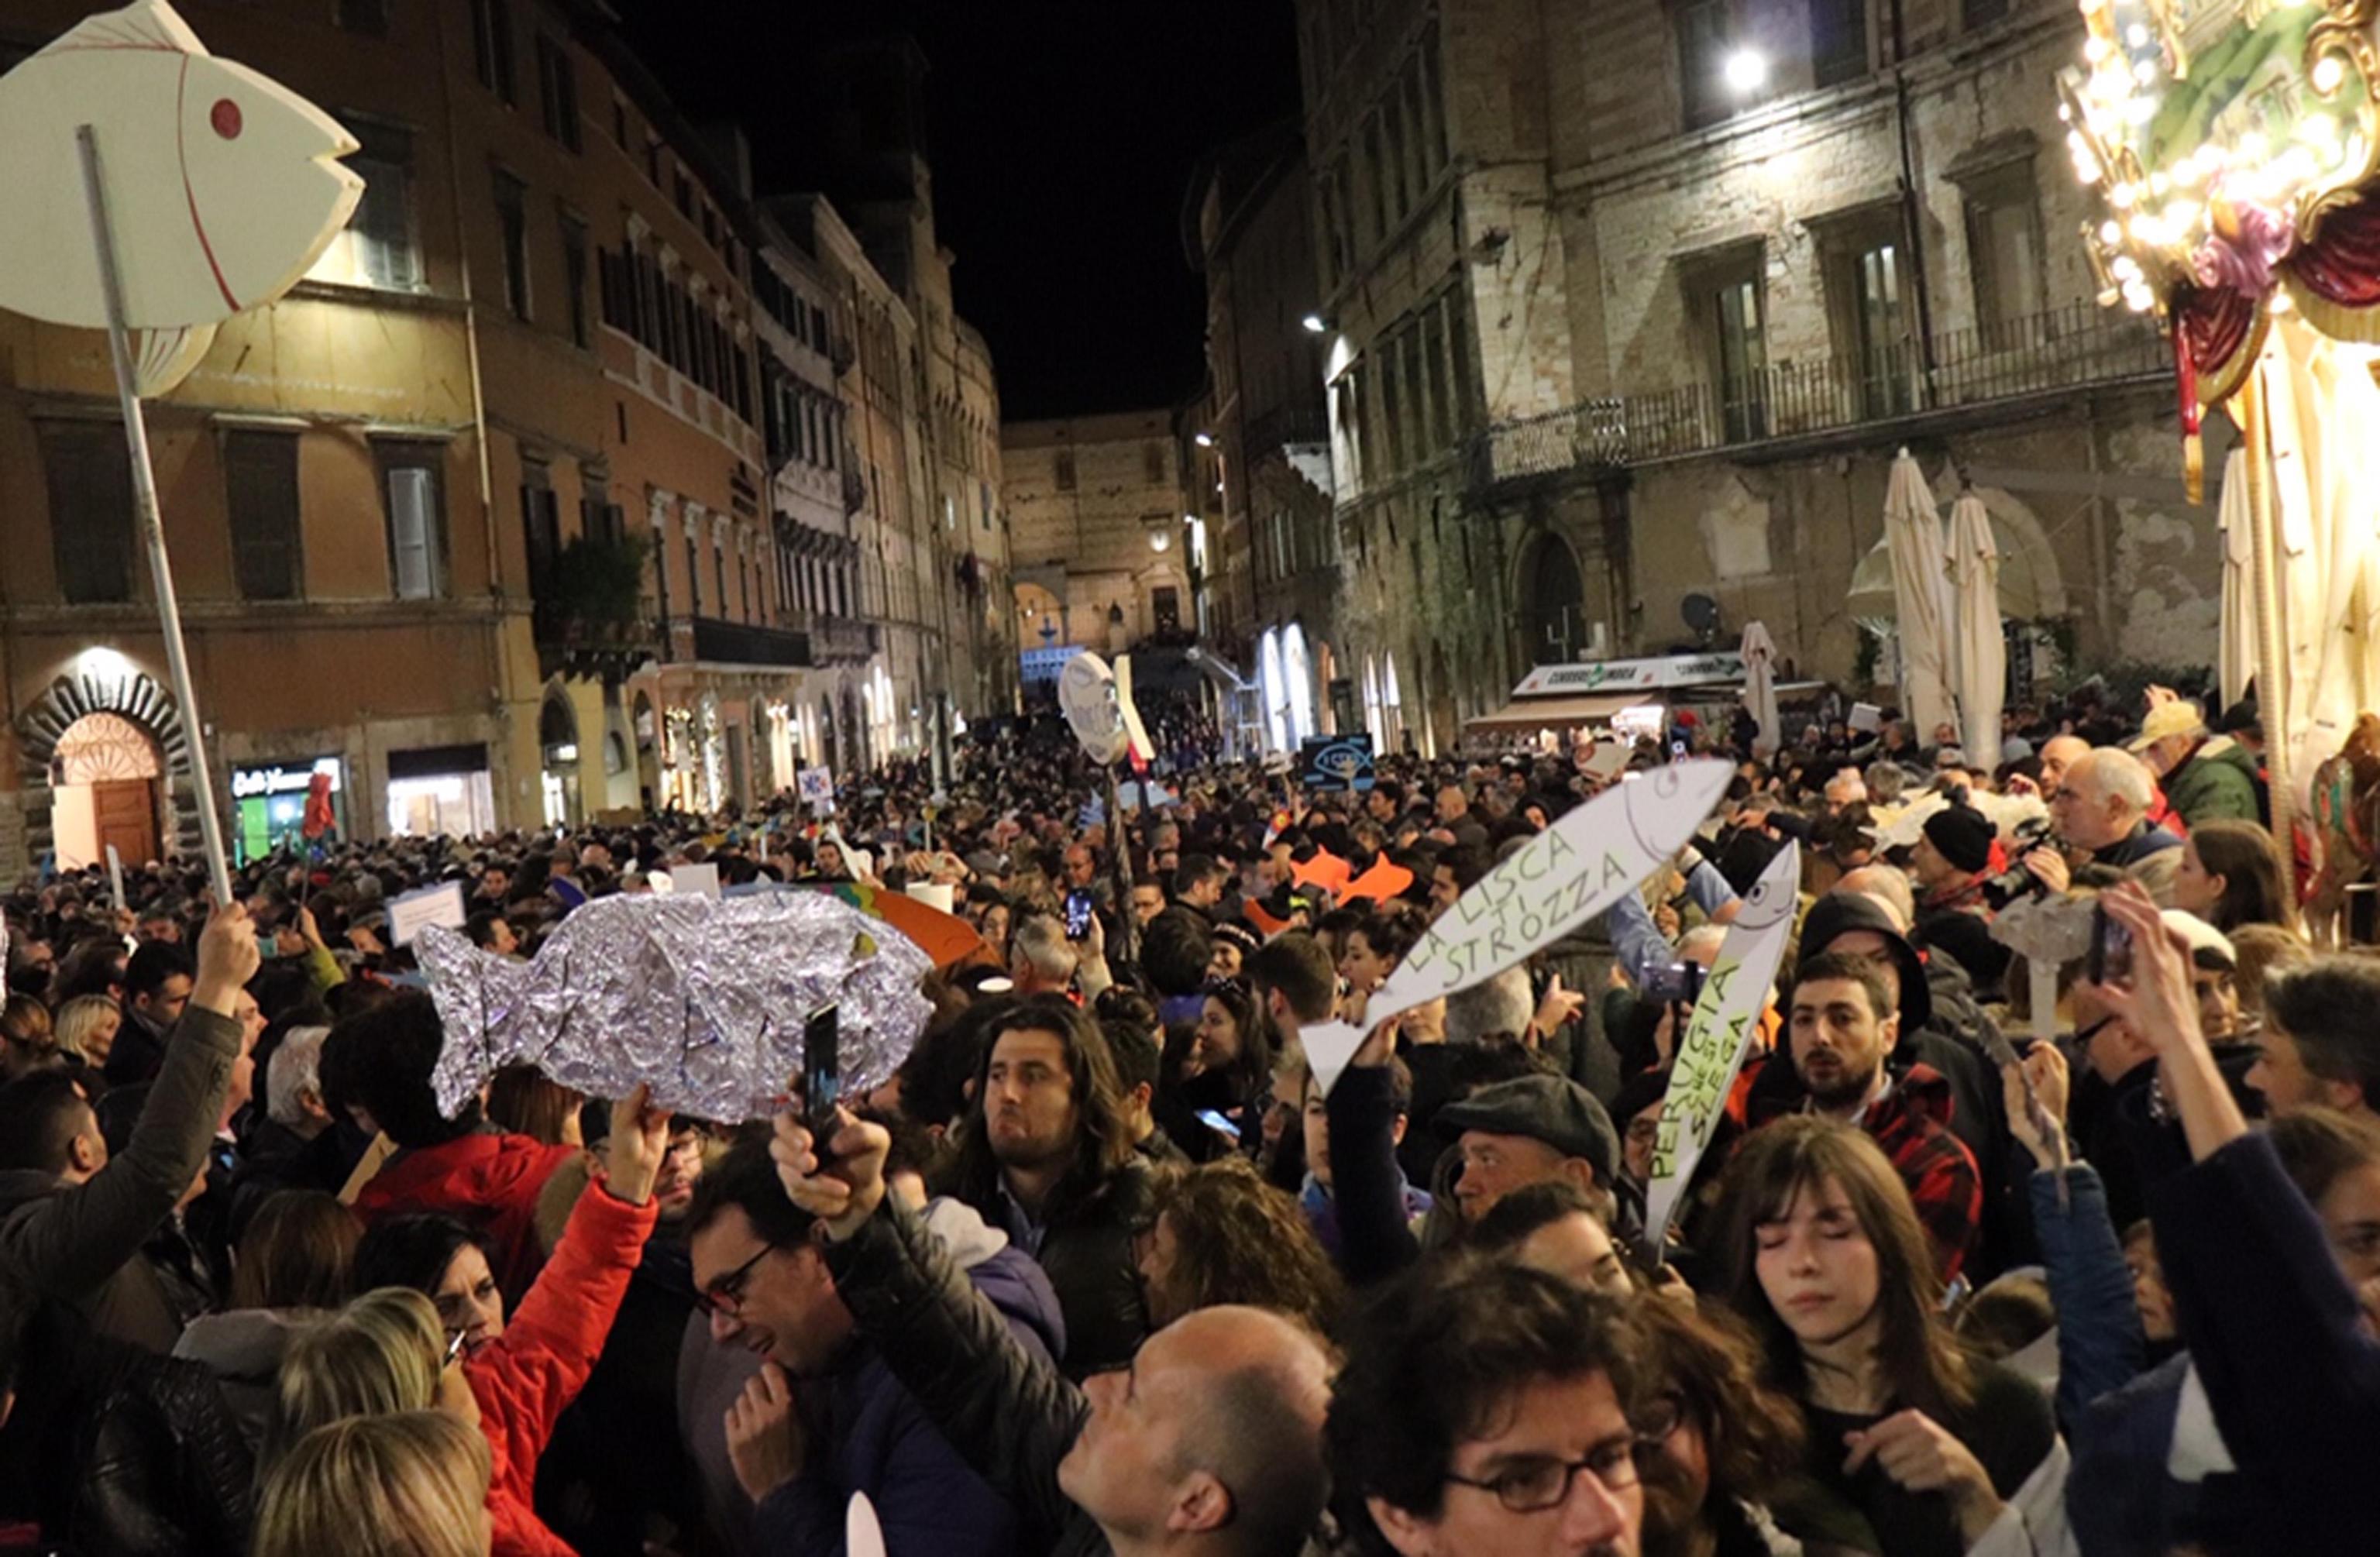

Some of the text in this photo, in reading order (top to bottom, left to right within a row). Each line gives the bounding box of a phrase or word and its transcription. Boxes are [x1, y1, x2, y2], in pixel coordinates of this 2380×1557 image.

[1406, 829, 1575, 973] LA LISCA
[1443, 852, 1628, 988] STROZZA
[1491, 895, 1526, 926] TI
[1649, 963, 1740, 1180] PERUGIA
[1690, 1015, 1749, 1149] SLEGA
